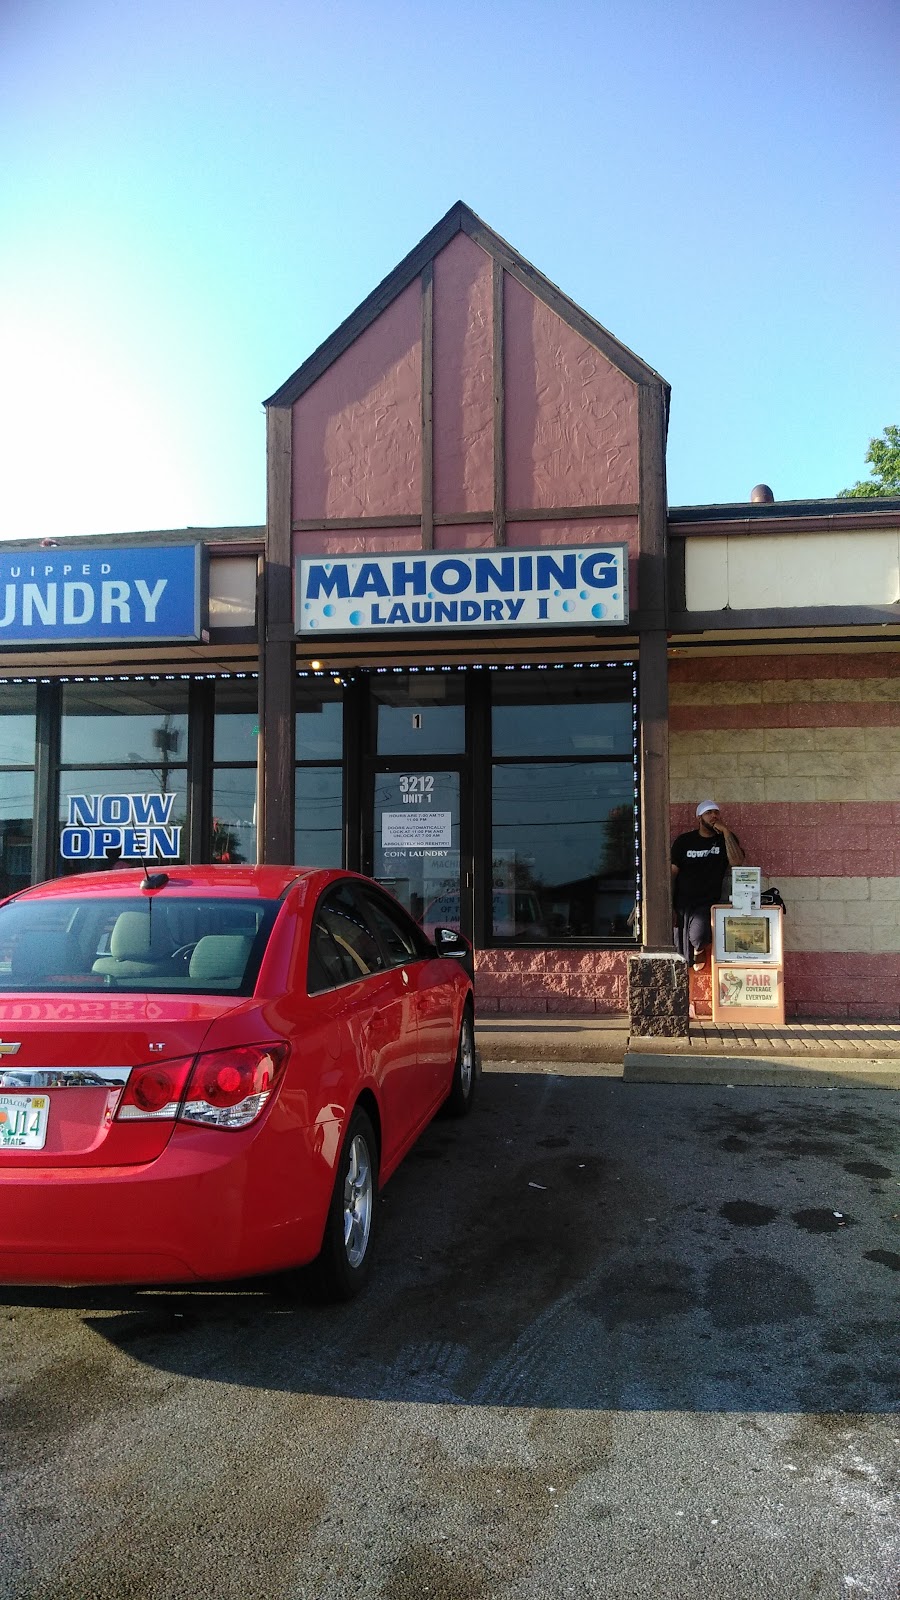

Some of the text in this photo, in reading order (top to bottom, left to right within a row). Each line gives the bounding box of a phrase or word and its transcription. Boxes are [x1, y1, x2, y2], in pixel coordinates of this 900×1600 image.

[0, 563, 111, 578] UIPPED
[305, 552, 618, 600] MAHONING
[371, 597, 549, 625] LAUNDRY I
[399, 775, 434, 792] 3212
[402, 793, 432, 804] UNIT 1
[66, 793, 177, 826] NOW
[60, 826, 183, 859] OPEN
[745, 974, 771, 987] FAIR
[148, 1042, 166, 1052] LT
[7, 1110, 41, 1136] J14
